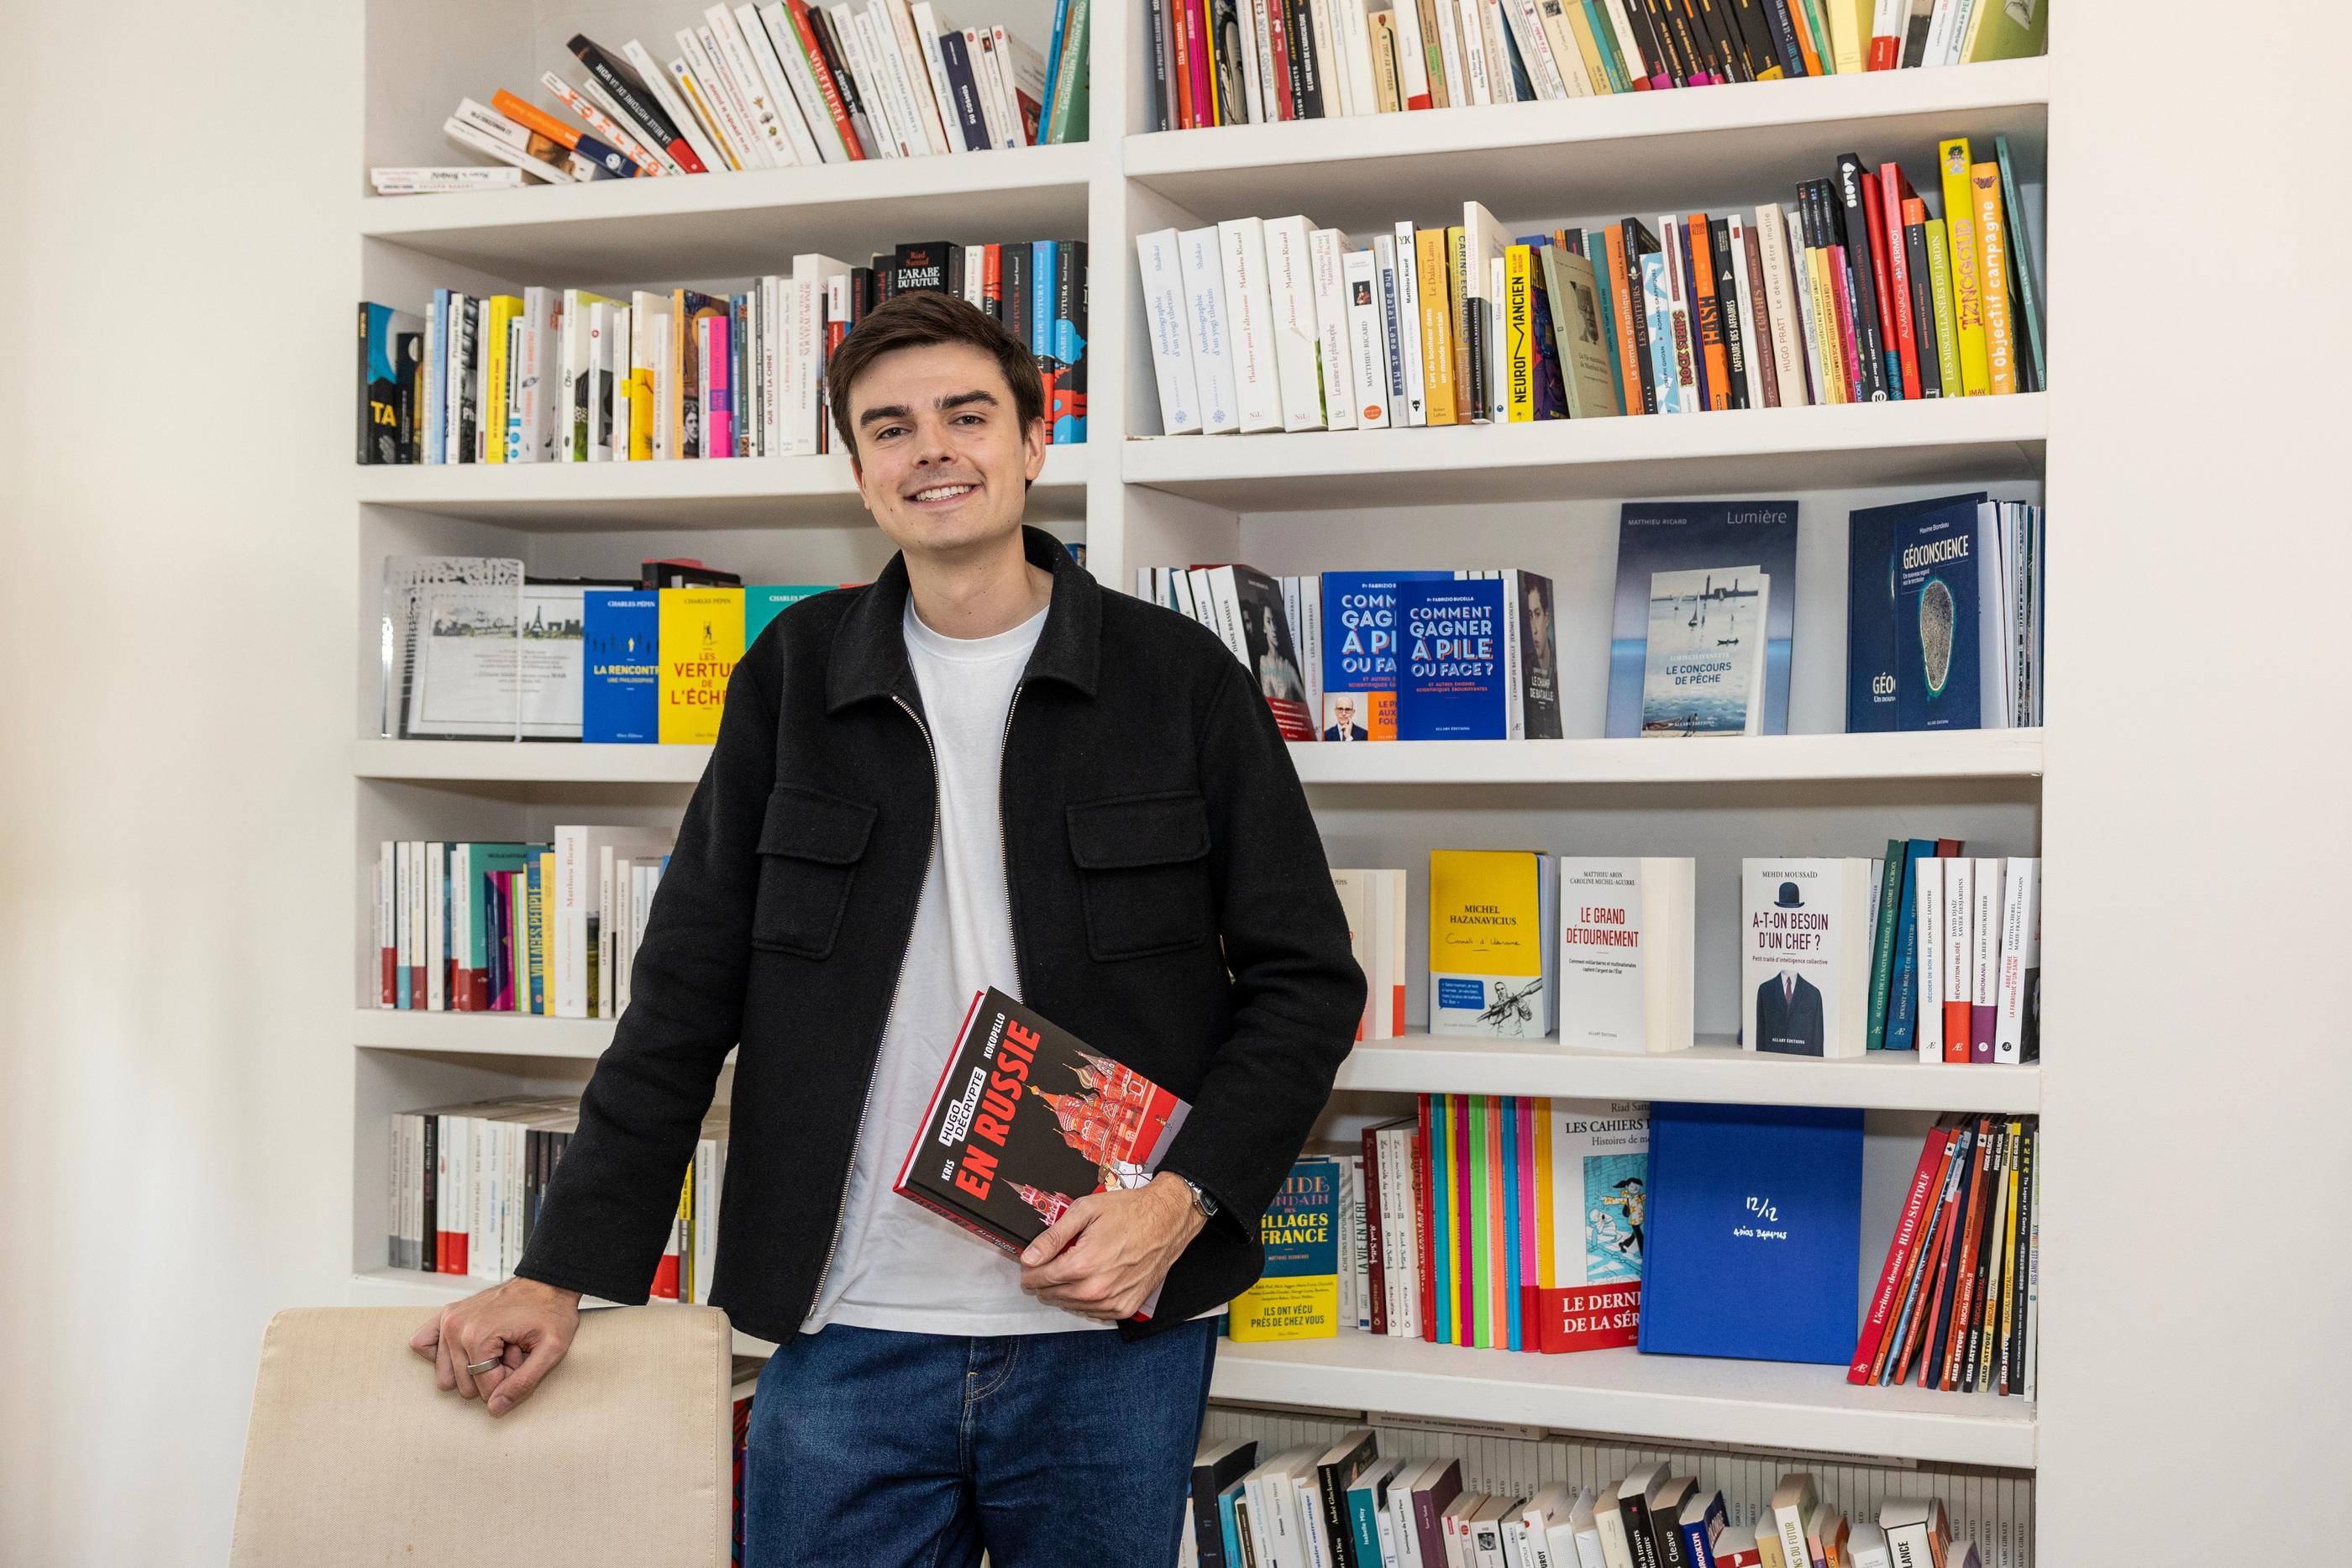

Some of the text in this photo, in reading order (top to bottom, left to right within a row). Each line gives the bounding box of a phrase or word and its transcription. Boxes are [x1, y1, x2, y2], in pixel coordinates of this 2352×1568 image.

[1062, 58, 1075, 112] NEIGHBORS
[962, 85, 973, 113] COSMOS
[1765, 212, 1774, 242] inutile
[1234, 231, 1244, 255] Ricard
[1279, 231, 1289, 255] Ricard
[898, 267, 940, 279] L'ARABE
[898, 277, 940, 288] DU FUTUR
[1892, 229, 1908, 338] ALMANACH VERMOT
[1955, 219, 1982, 330] IZNOGOUD
[1983, 201, 2008, 367] objectif campagne
[1458, 235, 1471, 343] CARING ECONOMICS
[1933, 235, 1954, 381] LES MISCELLANÉES DU JARDIN
[1384, 270, 1403, 390] The Lama MIT
[1621, 289, 1638, 380] Le roman graphique
[1726, 300, 1743, 372] L'AFFAIRE DES AFFAIRES
[1777, 317, 1788, 343] PRATT
[1362, 321, 1373, 387] MATTHIEU RICARD
[1672, 310, 1693, 387] ROCK STRIPS
[1782, 345, 1791, 372] HUGO
[370, 400, 396, 427] TA
[1727, 510, 1787, 524] Lumière
[1903, 535, 1969, 569] GÉOCONSCIENCE
[1341, 610, 1396, 628] GAG
[1410, 606, 1493, 620] COMMENT
[1223, 599, 1238, 653] DIANE BRASSEUR
[1410, 620, 1493, 637] GAGNER
[699, 653, 716, 661] LES
[1436, 638, 1494, 660] PILE
[593, 665, 607, 675] LA
[674, 663, 738, 677] VERTU
[1411, 662, 1494, 678] OU FACE ?
[1666, 662, 1732, 675] LE CONCOURS
[1675, 673, 1721, 685] DE PÊCHE
[671, 688, 727, 705] L'ÉCH
[1784, 870, 1818, 878] MOUSSAÏD
[1450, 915, 1517, 926] HAZANAVICIUS
[1464, 905, 1500, 914] MICHEL
[1581, 907, 1625, 925] LE GRAND
[1752, 912, 1829, 931] A-T-ON BESOIN
[1567, 925, 1639, 948] DÉTOURNEMENT
[1759, 932, 1821, 951] D'UN CHEF ?
[1776, 956, 1805, 964] d'intelligence
[984, 1012, 1005, 1060] KOKOPELLO
[974, 1020, 1041, 1147] RUSSIE
[955, 1071, 984, 1138] DÉCRYPTE
[1611, 1102, 1630, 1113] Riad
[942, 1104, 961, 1142] HUGO
[1566, 1119, 1644, 1134] LES CAHIERS
[1592, 1135, 1638, 1146] Histoires de
[941, 1159, 955, 1182] KRIS
[955, 1144, 999, 1201] EN
[1746, 1197, 1778, 1221] 12/12
[1261, 1229, 1328, 1245] FRANCE
[1355, 1201, 1368, 1275] LA VIE EN VERT
[1734, 1225, 1788, 1240] ADIOS BAHAMAS
[1873, 1170, 1929, 1324] L'écriture dessinée RIAD SATTOUF
[1263, 1303, 1313, 1316] ILS ONT VÉCU
[1562, 1297, 1585, 1313] LE
[1272, 1314, 1325, 1327] DE CHEZ VOUS
[1563, 1318, 1587, 1333] DE
[1590, 1316, 1611, 1330] LA
[1951, 1305, 1968, 1382] RIAD SATTOUF PASCAL
[1326, 1467, 1339, 1524] André Glucksmann
[1361, 1523, 1369, 1545] Isabelle
[1786, 1522, 1798, 1545] FUTUR
[1667, 1531, 1679, 1562] Cleave
[1790, 1546, 1800, 1556] DU
